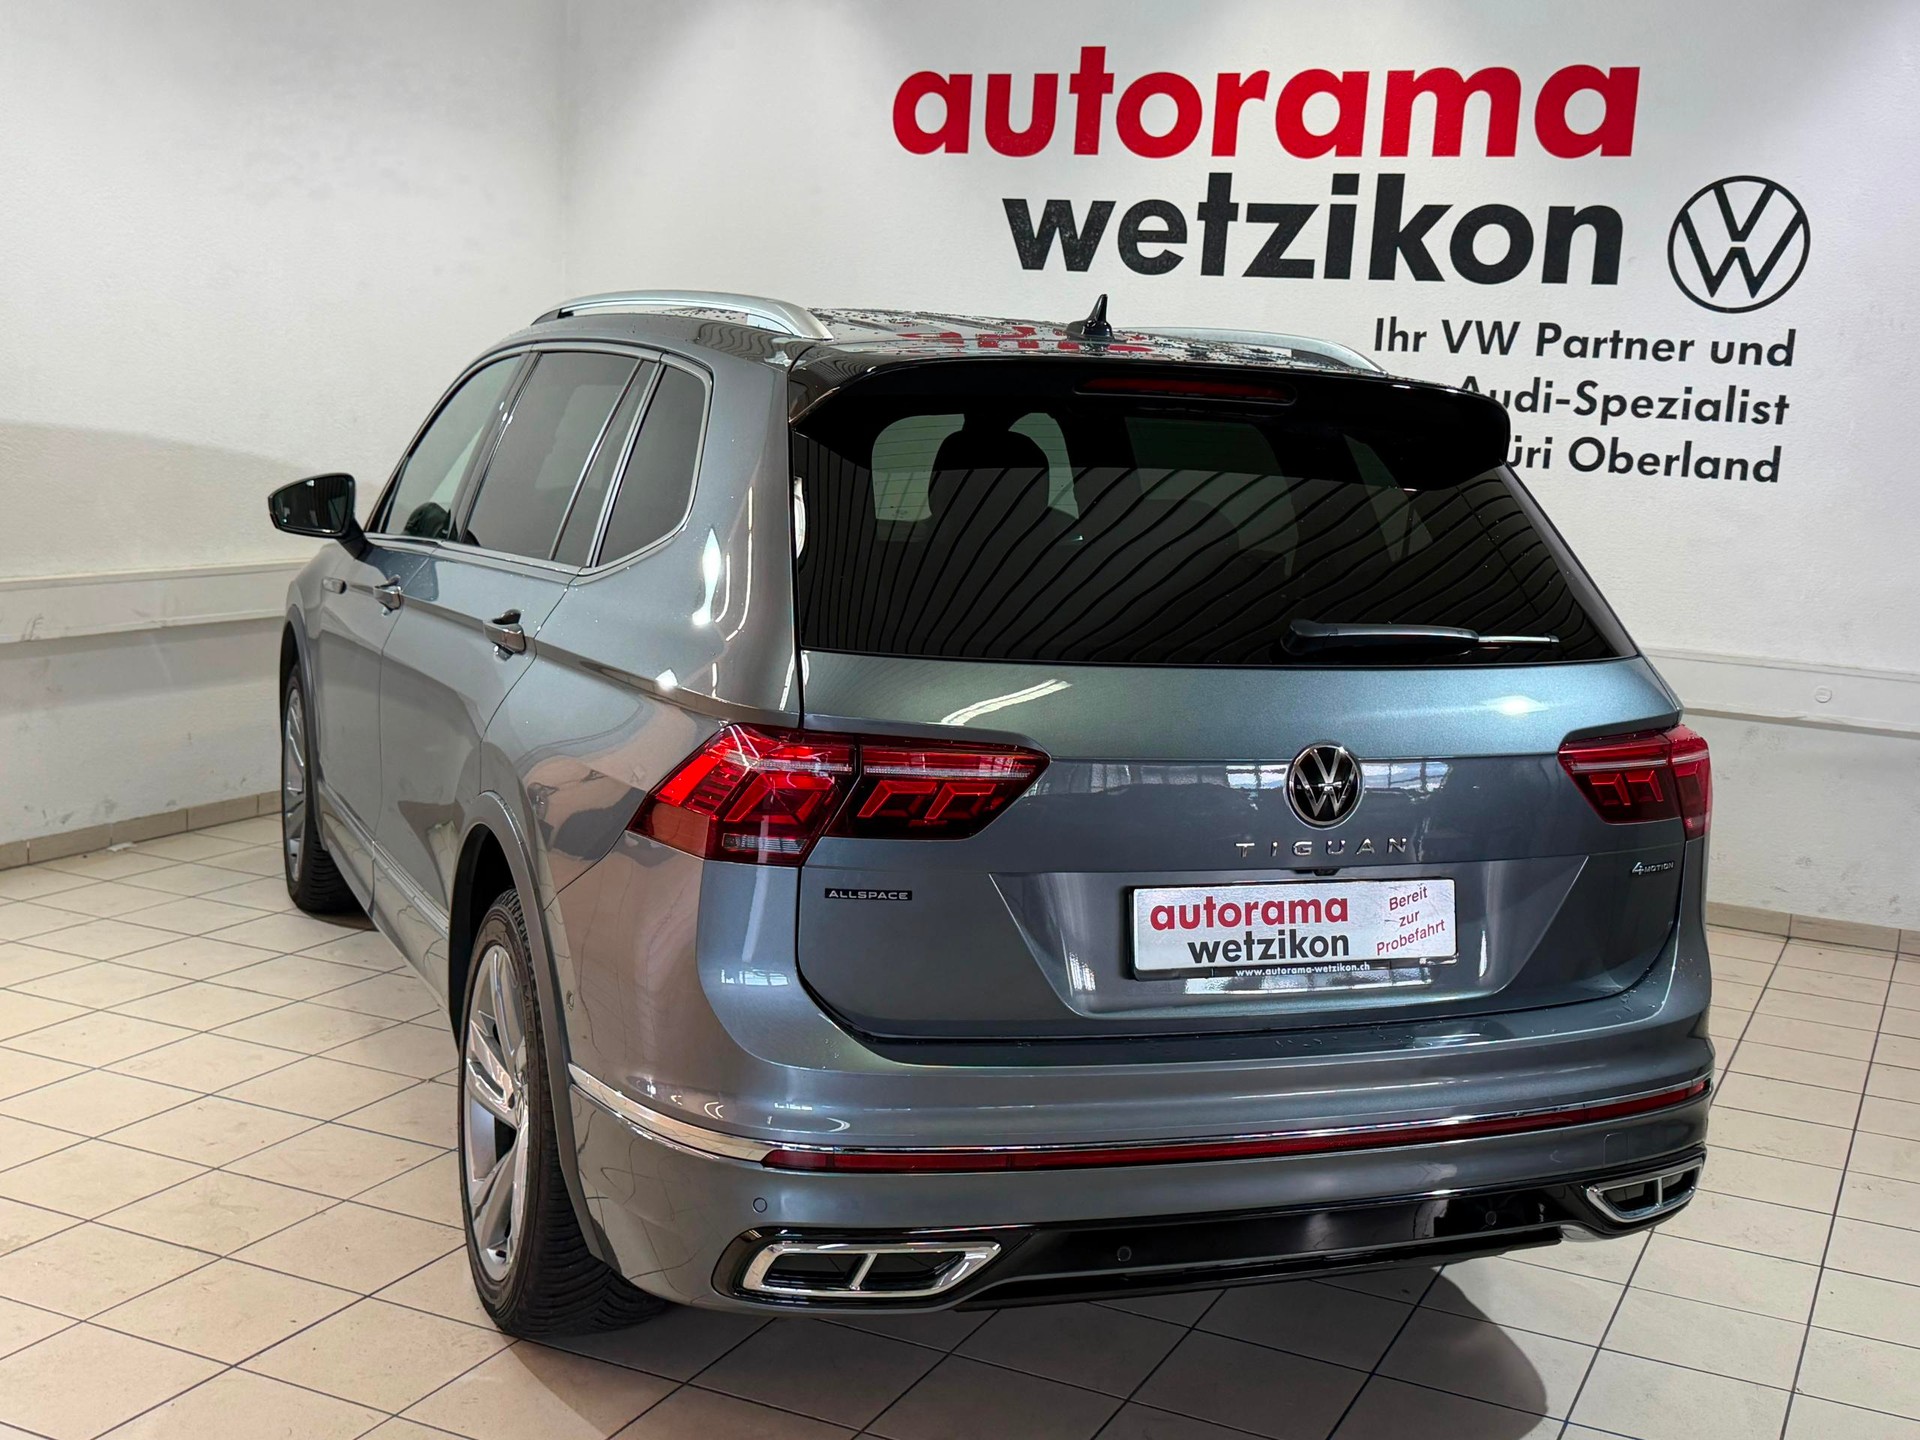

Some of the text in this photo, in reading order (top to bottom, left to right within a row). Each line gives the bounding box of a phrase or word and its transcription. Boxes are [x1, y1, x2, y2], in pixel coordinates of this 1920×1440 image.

[892, 46, 1641, 160] autorama
[1002, 172, 1624, 286] wetzikon
[1373, 316, 1797, 367] Ihr VW Partner und
[1568, 436, 1783, 483] Oberland
[1235, 838, 1407, 857] TIGUAN
[1632, 862, 1674, 875] 4MOTION
[829, 890, 908, 900] ALLSPACE
[1389, 886, 1428, 911] Bereit
[1150, 896, 1349, 931] autorama
[1399, 911, 1420, 927] zur
[1187, 928, 1350, 964] wetzikon
[1376, 919, 1446, 956] Probefahrt
[1236, 962, 1370, 976] www.autorama-wetzikon.ch
